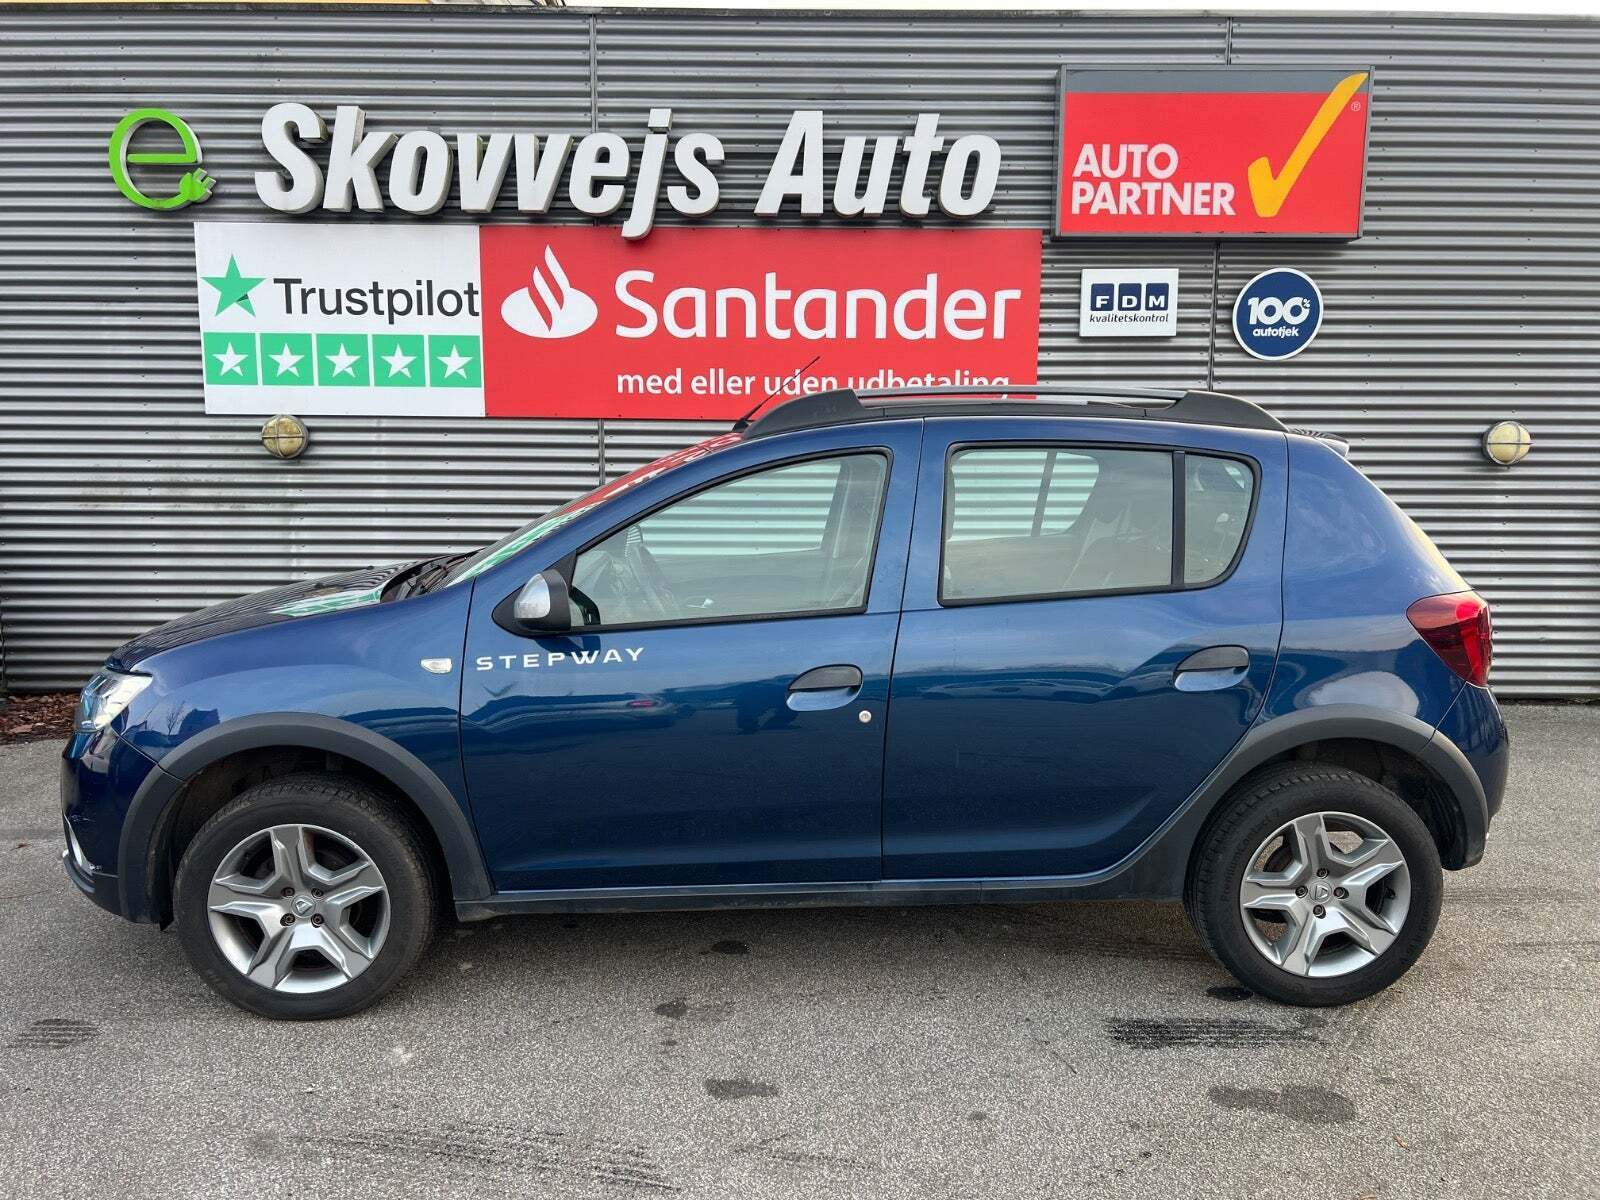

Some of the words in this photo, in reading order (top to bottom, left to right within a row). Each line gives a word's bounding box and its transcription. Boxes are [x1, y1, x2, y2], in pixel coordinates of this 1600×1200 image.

[254, 102, 725, 241] Skovvejs
[754, 110, 1002, 218] Auto
[1072, 143, 1179, 179] AUTO
[1071, 182, 1236, 216] PARTNER
[273, 278, 480, 325] Trustpilot
[614, 269, 1022, 341] Santander
[1094, 293, 1166, 309] FDM
[1247, 296, 1311, 325] 100%
[1089, 313, 1169, 323] kvalitetskontrol
[1252, 326, 1299, 339] autotjek
[617, 367, 682, 395] med
[690, 367, 756, 395] eller
[764, 368, 838, 396] uden
[476, 647, 644, 671] STEPWAY
